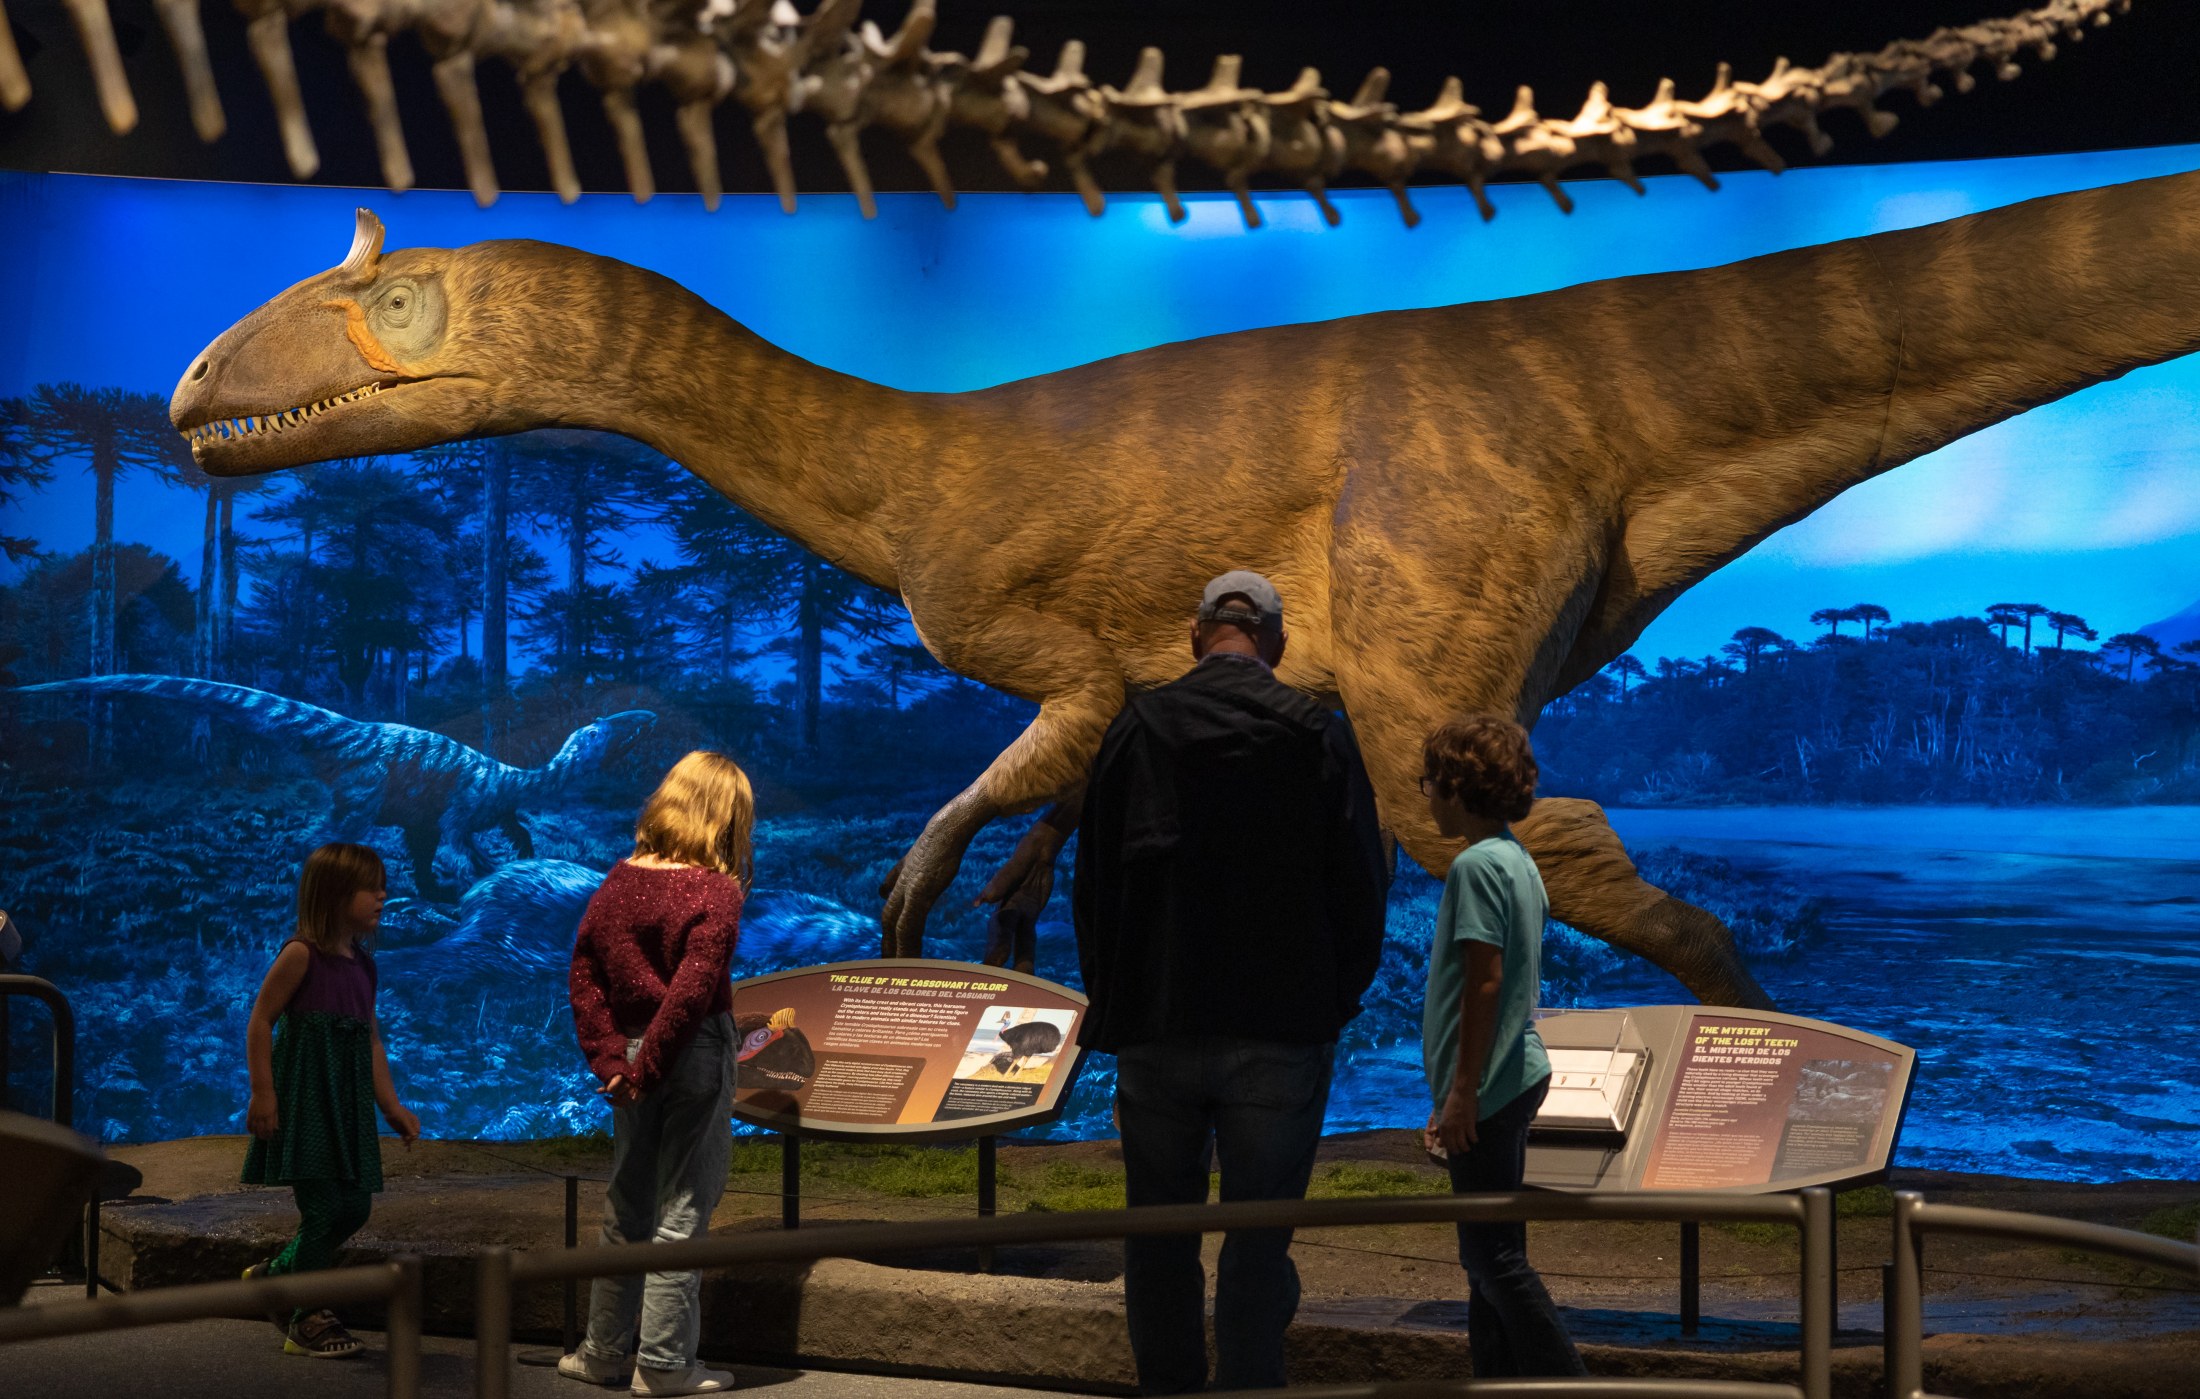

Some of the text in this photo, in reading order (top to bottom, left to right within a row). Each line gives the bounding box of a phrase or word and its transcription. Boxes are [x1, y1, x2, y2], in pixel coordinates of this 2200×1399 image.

[830, 975, 1009, 991] THE CLUE OF THE CASSOWARY COLORS
[844, 986, 871, 994] CLAVE
[901, 989, 937, 997] COLORES
[955, 992, 996, 1000] CASUARIO
[1700, 1026, 1770, 1036] THE MYSTERY
[1712, 1037, 1733, 1045] THE
[1734, 1038, 1761, 1046] LOST
[1764, 1039, 1798, 1047] TEETH
[1709, 1047, 1755, 1055] MISTERIO
[1734, 1057, 1782, 1065] PERDIDOS
